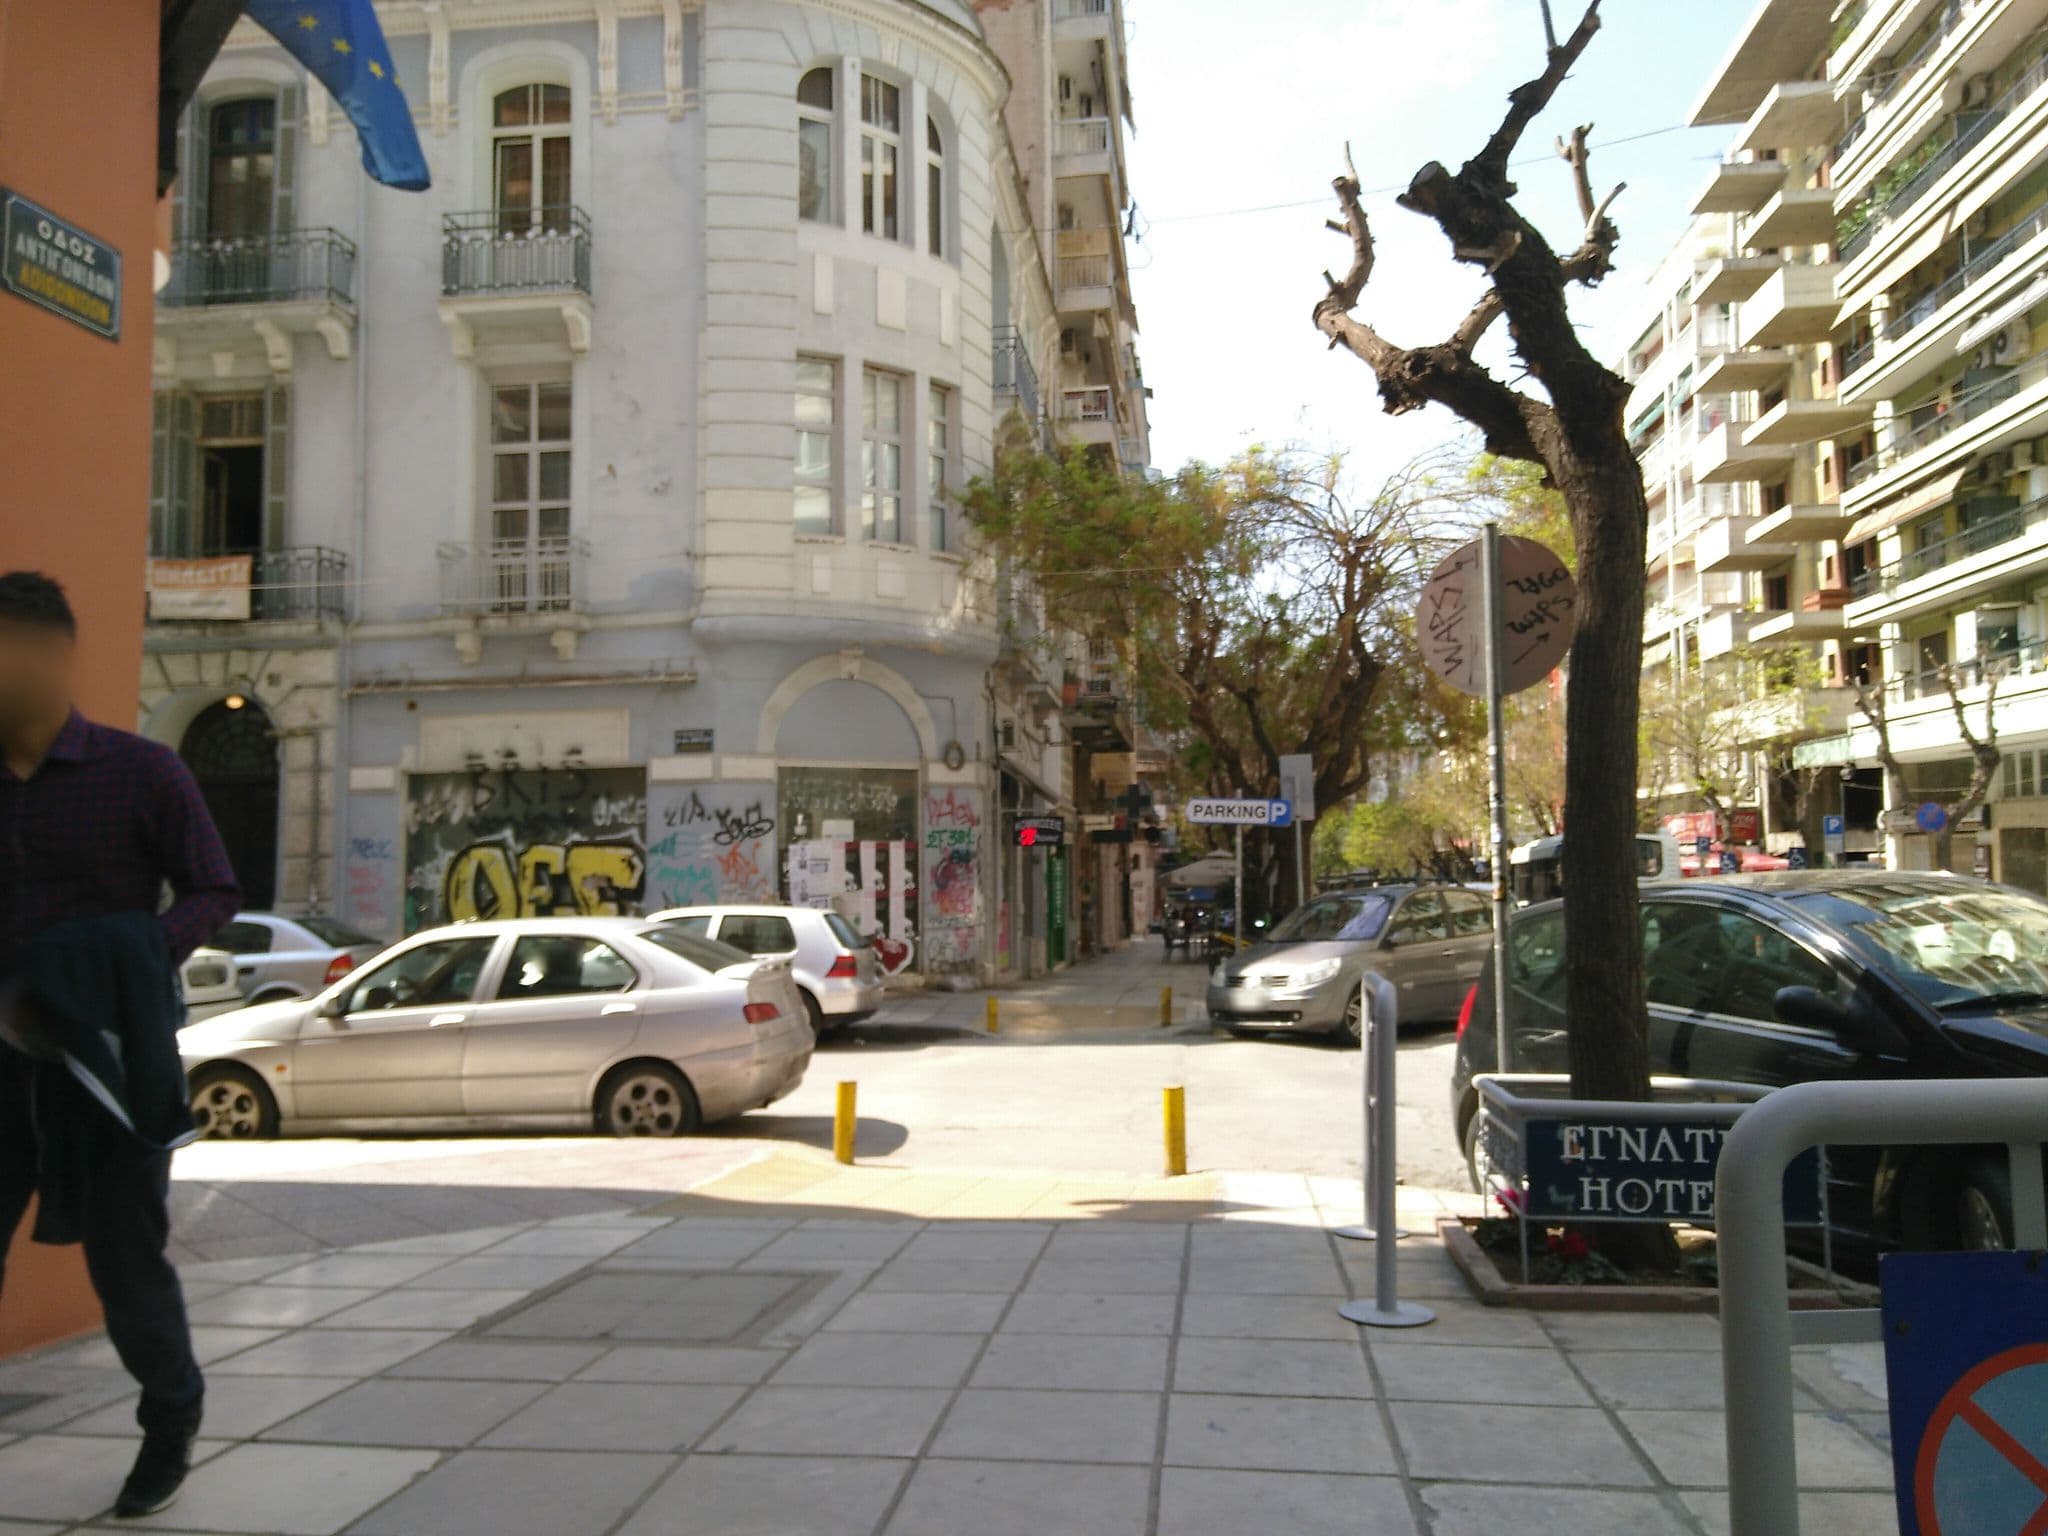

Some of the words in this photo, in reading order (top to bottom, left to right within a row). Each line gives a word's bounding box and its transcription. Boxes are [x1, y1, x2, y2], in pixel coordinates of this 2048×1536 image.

[38, 219, 97, 265] ΟΔΟΣ
[1193, 804, 1266, 818] PARKING
[1270, 803, 1287, 822] P
[1560, 1125, 1729, 1164] ΕΓΝΑΤ
[1578, 1177, 1714, 1217] HOTE
